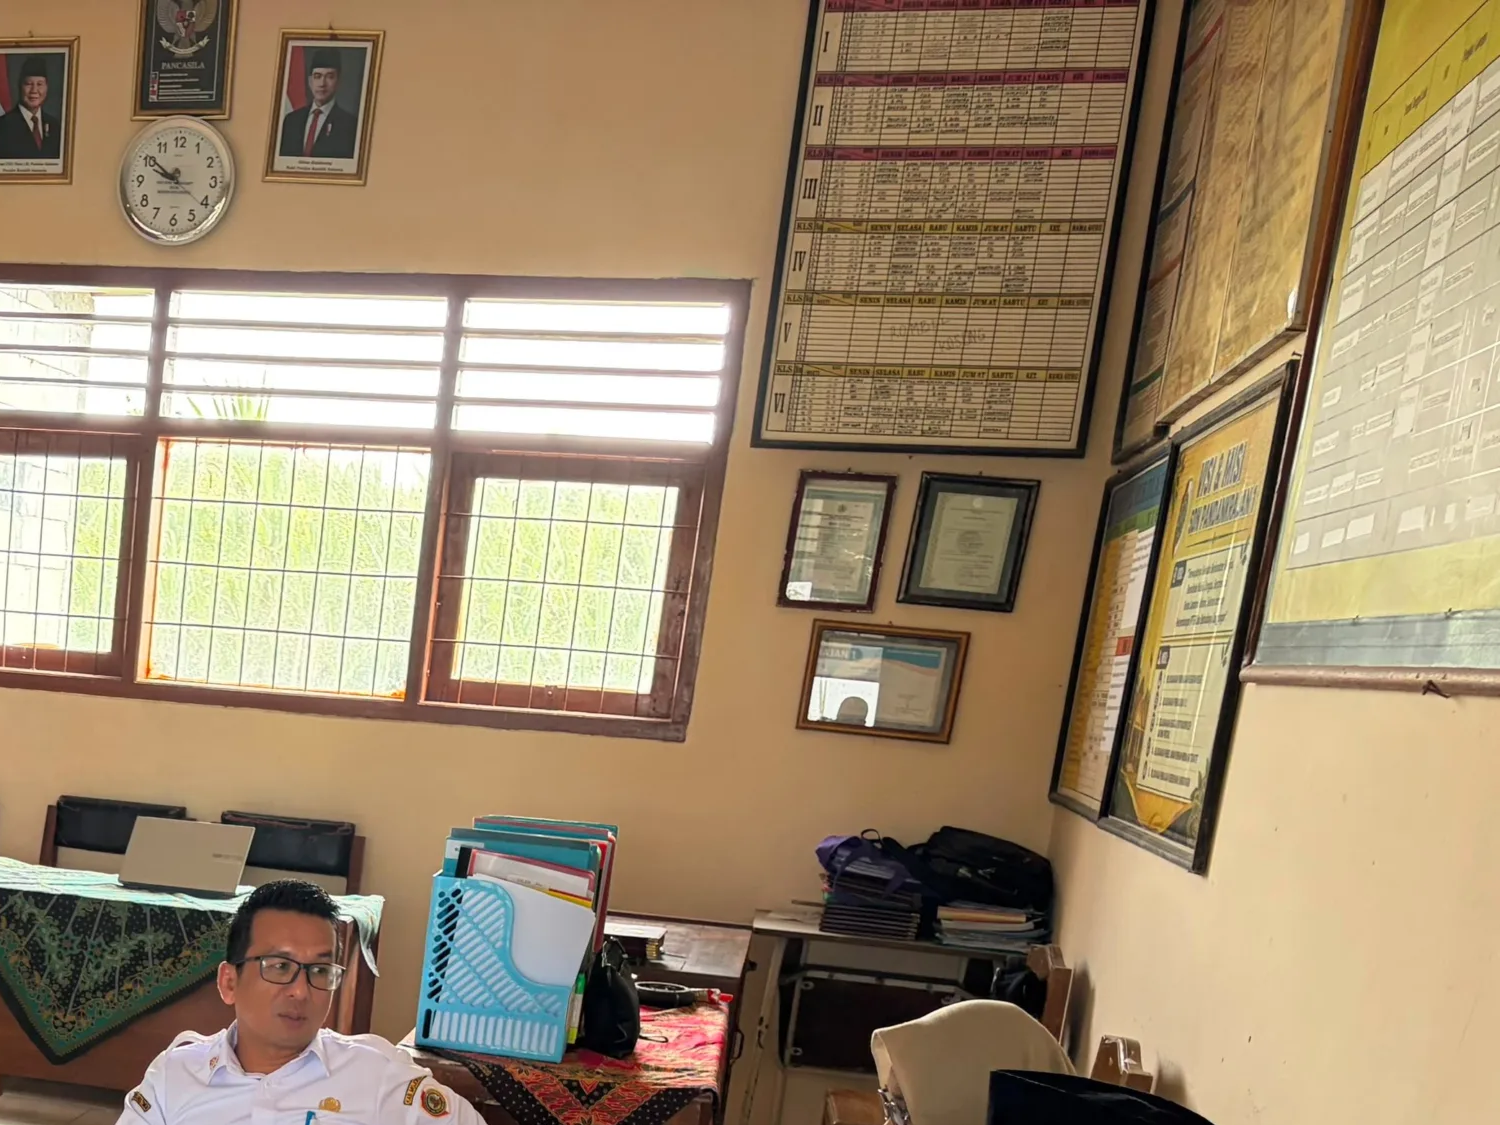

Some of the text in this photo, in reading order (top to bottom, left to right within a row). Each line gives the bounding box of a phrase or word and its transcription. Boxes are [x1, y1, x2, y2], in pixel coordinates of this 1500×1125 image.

[161, 62, 206, 70] PANCASILA
[157, 136, 200, 154] 11 12 1
[143, 156, 214, 168] 10 2
[136, 174, 144, 188] 9
[209, 176, 217, 188] 3
[802, 178, 818, 199] III
[140, 194, 209, 208] 8 4
[153, 207, 196, 226] 7 6 5
[797, 222, 813, 230] KLS
[792, 251, 806, 271] IV
[787, 294, 802, 302] KLS
[784, 322, 792, 343] V
[774, 393, 786, 413] VI
[1196, 455, 1218, 498] VISI
[1222, 441, 1248, 488] MISI
